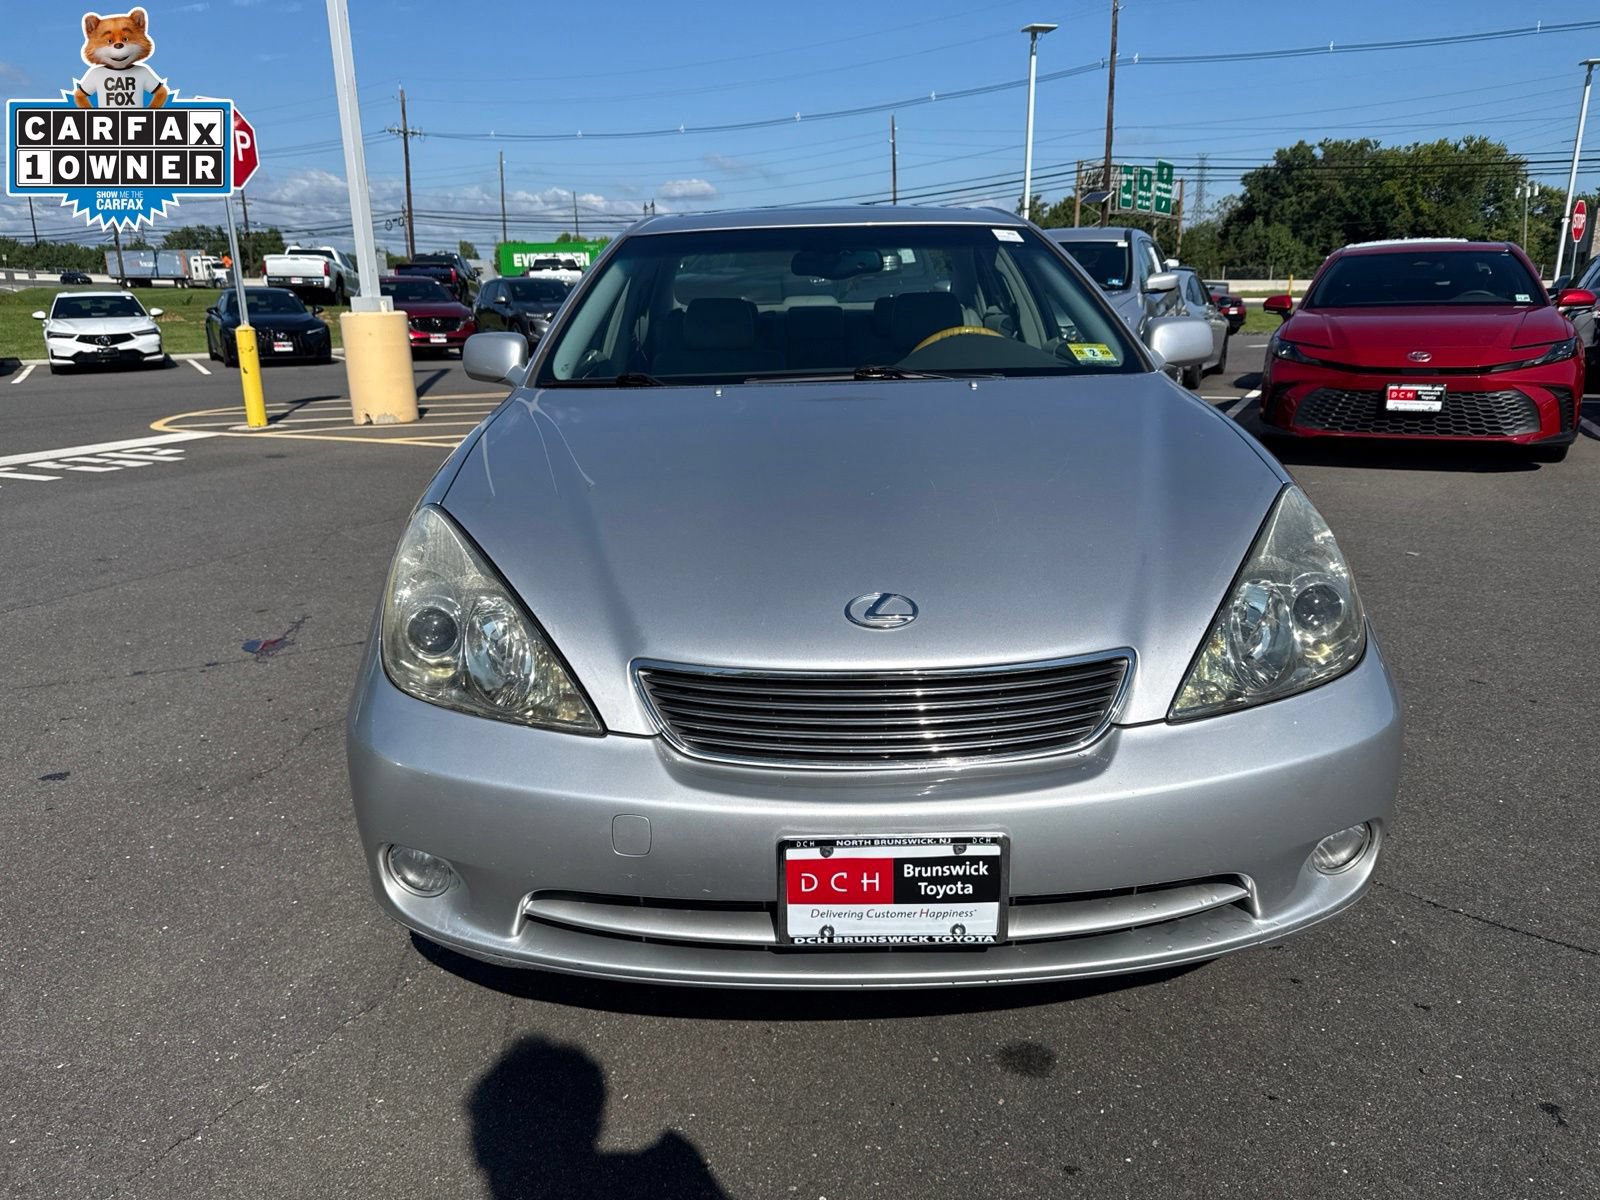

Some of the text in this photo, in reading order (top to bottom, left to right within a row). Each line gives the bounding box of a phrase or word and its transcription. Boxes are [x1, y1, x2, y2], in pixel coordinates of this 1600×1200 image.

[1573, 214, 1585, 228] STOP
[1390, 391, 1414, 399] DCH
[796, 840, 815, 848] DCH
[836, 839, 871, 847] NORTH
[938, 836, 952, 845] NJ
[972, 836, 992, 844] DCH
[903, 860, 989, 878] Brunswick
[801, 872, 879, 892] DCH
[917, 880, 974, 899] Toyota
[810, 908, 864, 921] Delivering
[866, 908, 918, 919] Customer
[793, 935, 996, 945] DCH BRUNSWICK TOYOTA
